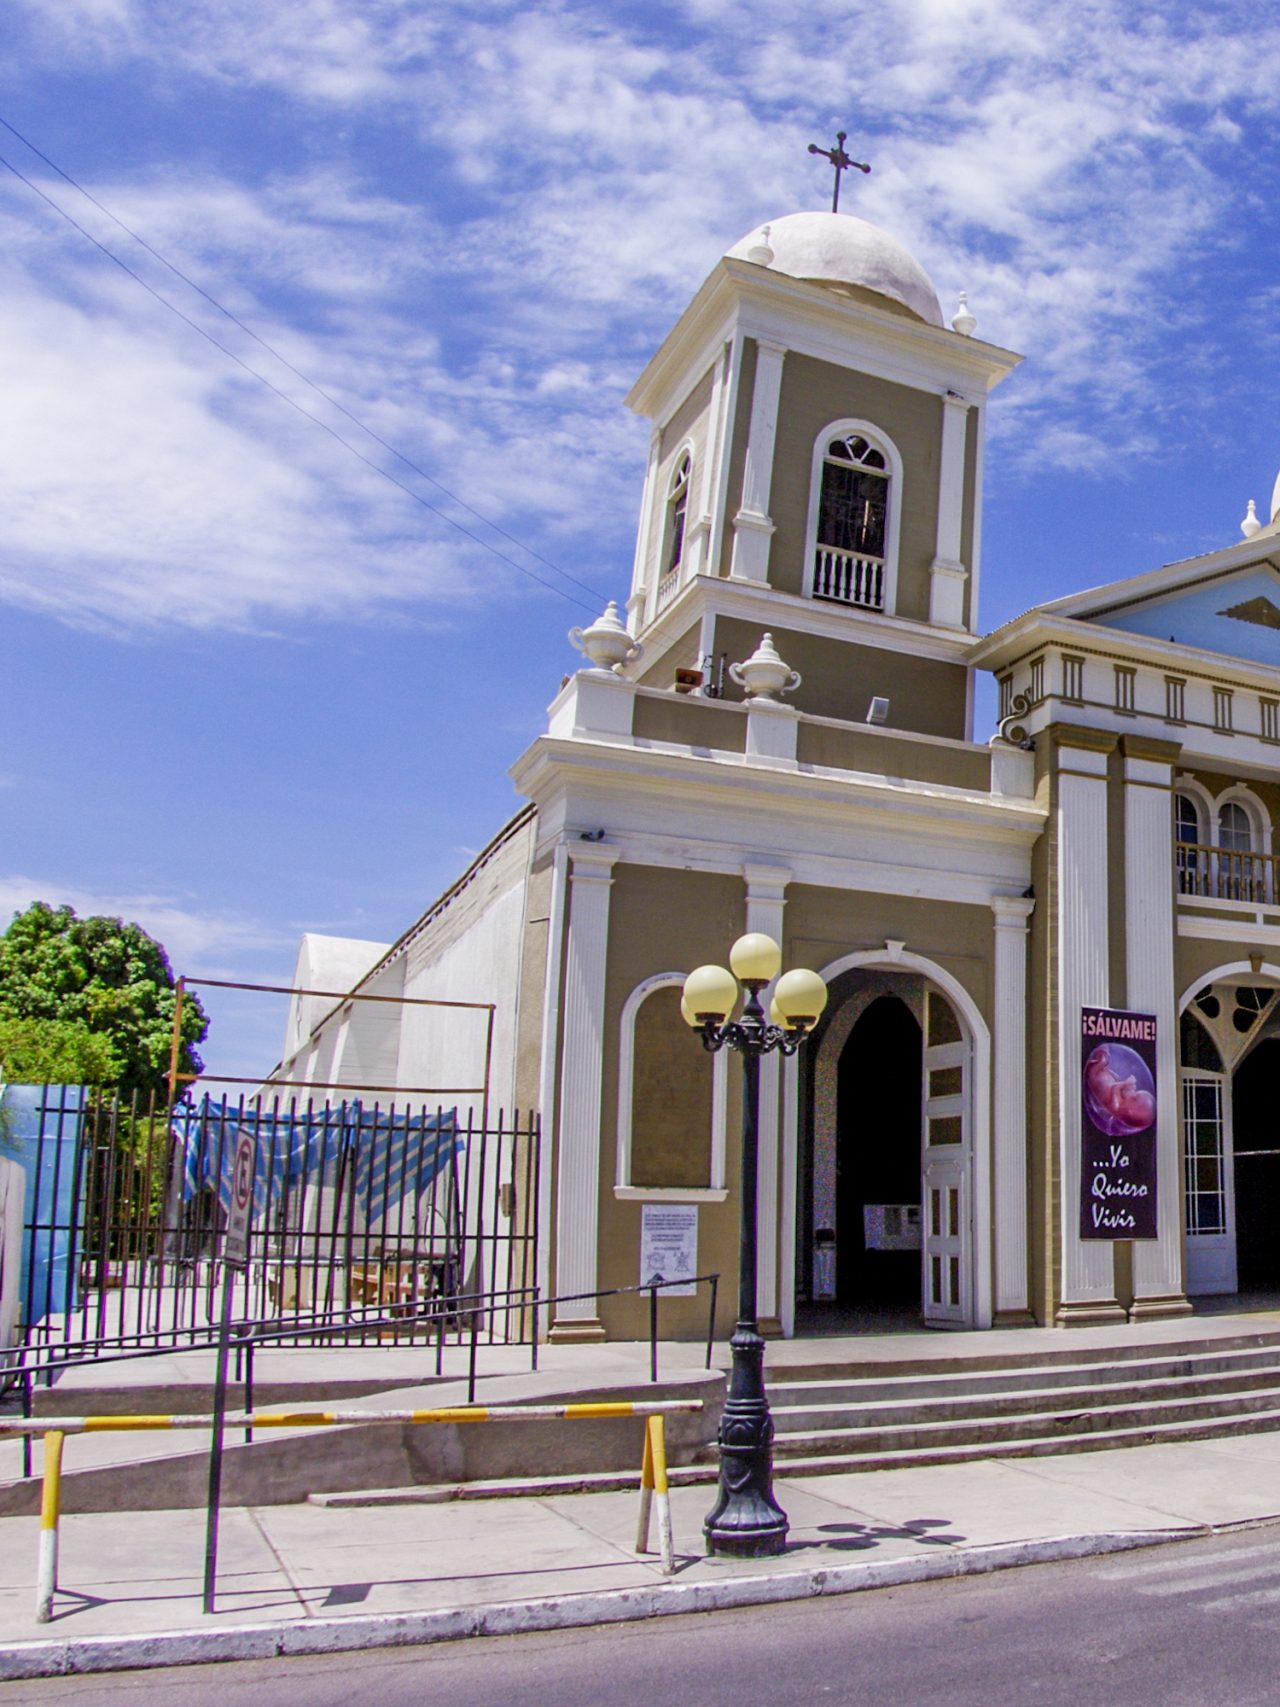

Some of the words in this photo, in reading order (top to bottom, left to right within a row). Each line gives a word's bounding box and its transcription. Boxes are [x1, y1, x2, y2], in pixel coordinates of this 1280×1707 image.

[1083, 1012, 1156, 1040] ¡SÁLVAME!
[1092, 1173, 1148, 1200] Quiero
[1092, 1203, 1136, 1228] Vivir
